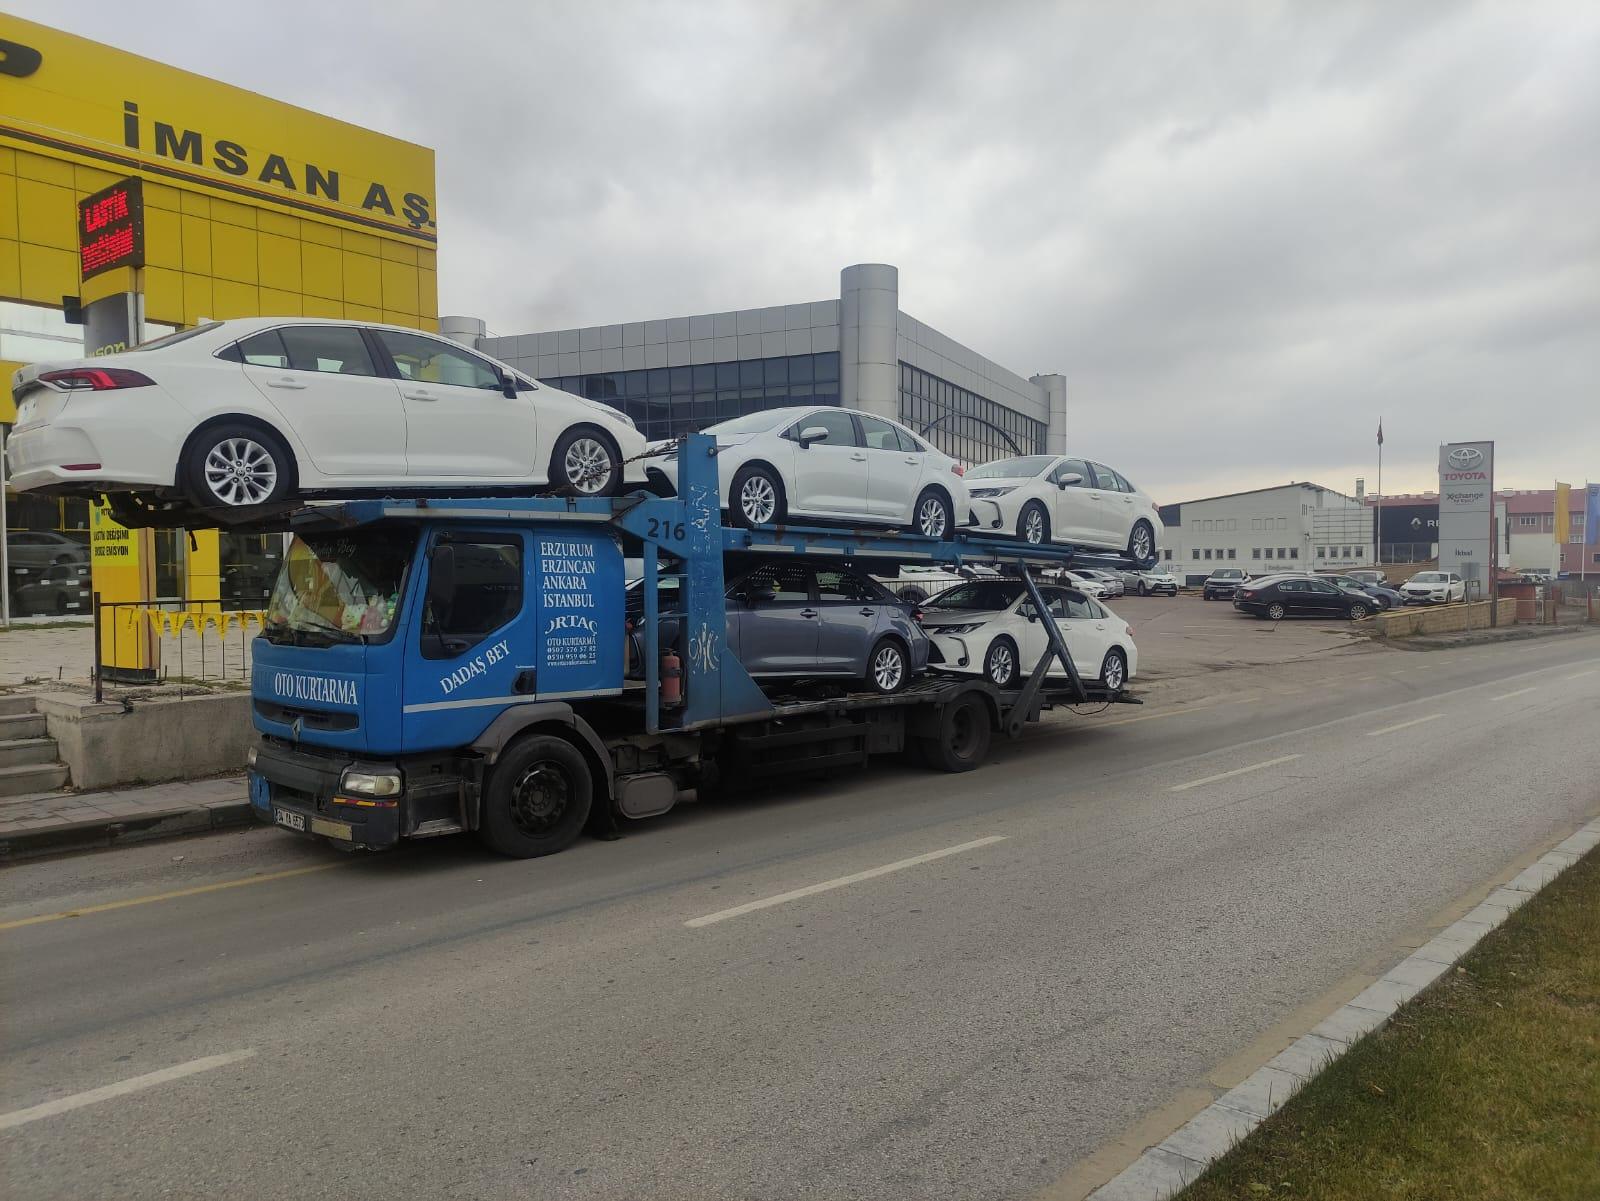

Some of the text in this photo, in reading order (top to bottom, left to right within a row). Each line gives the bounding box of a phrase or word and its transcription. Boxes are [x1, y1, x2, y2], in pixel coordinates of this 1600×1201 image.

[124, 100, 340, 202] İMSAN
[1444, 472, 1487, 481] TOYOTA
[647, 518, 686, 541] 216
[541, 542, 594, 557] ERZURUM
[542, 557, 596, 574] ERZİNCAN
[543, 575, 588, 590] ANKARA
[543, 590, 595, 608] İSTANBUL
[547, 637, 561, 646] OTO
[440, 639, 511, 694] DADAŞ BEY
[274, 672, 359, 705] OTO KURTARMA
